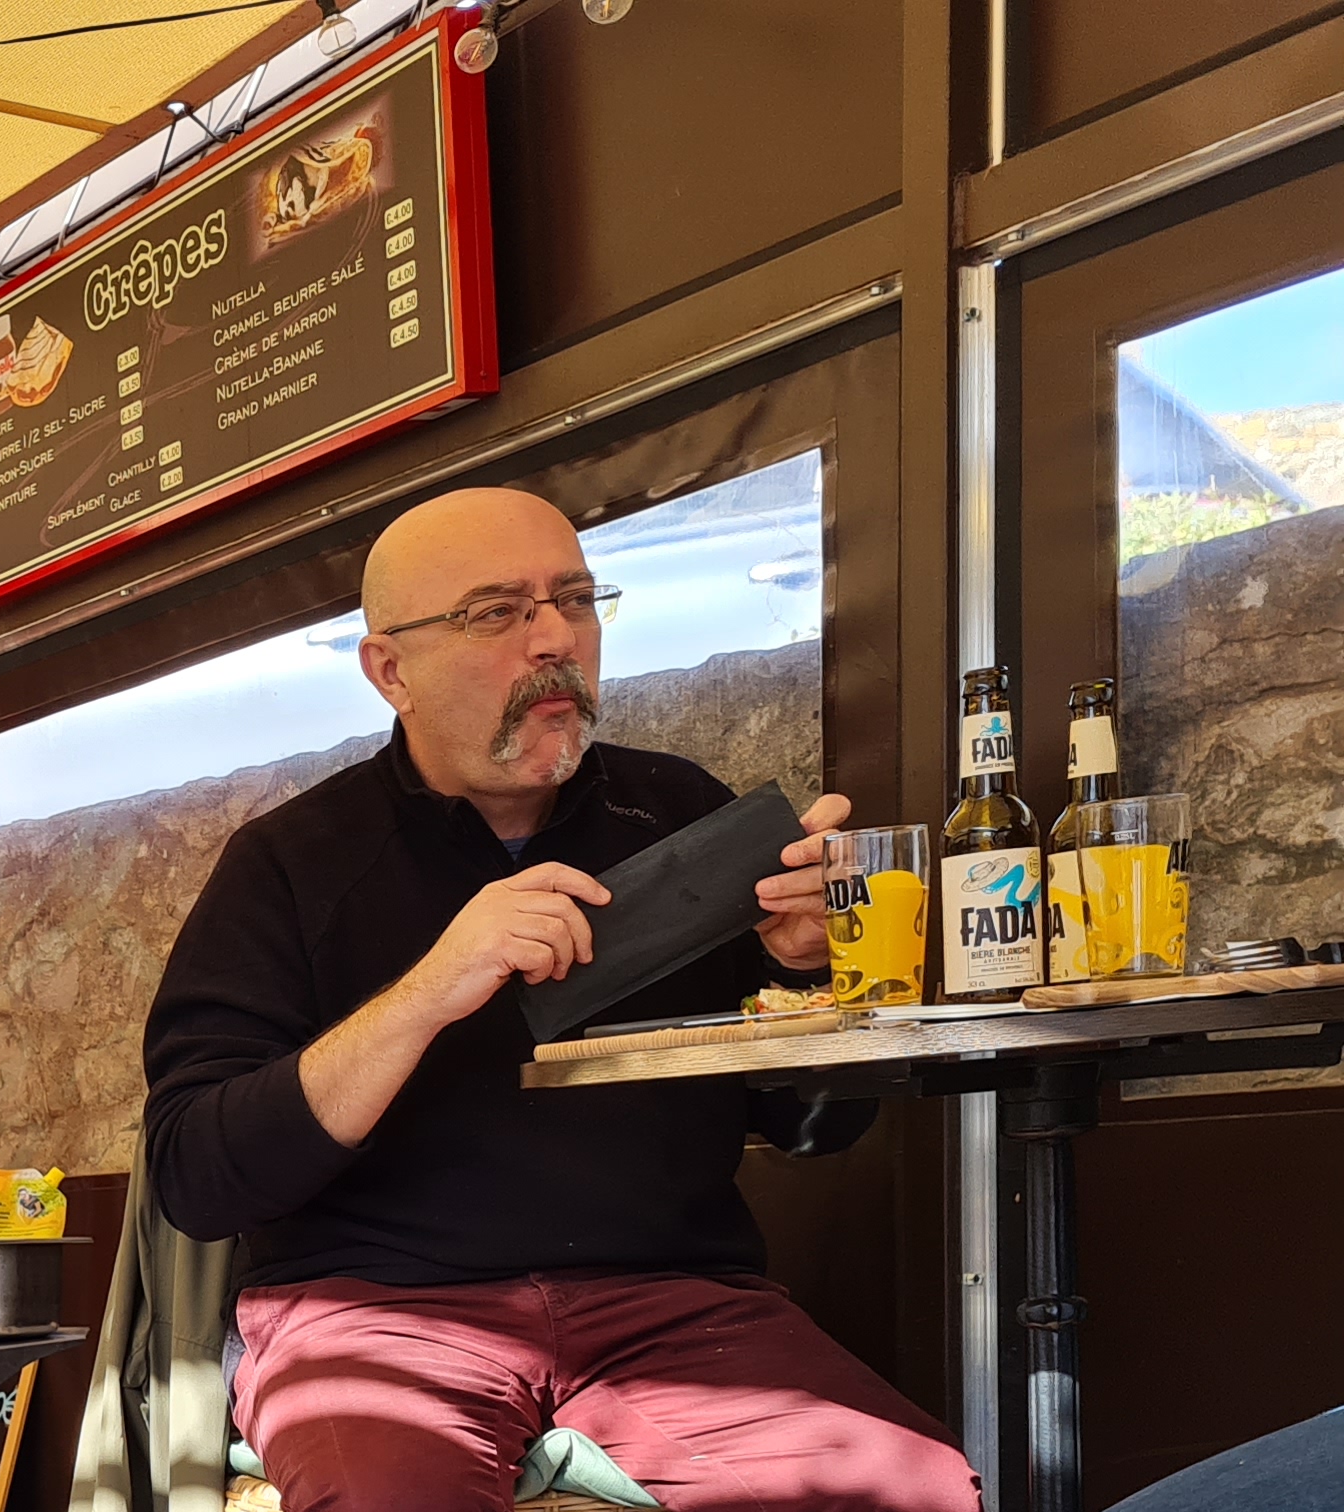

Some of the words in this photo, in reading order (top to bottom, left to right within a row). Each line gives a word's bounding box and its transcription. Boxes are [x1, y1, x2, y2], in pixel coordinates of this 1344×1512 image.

[84, 208, 228, 331] Crêpes
[212, 281, 266, 319] NUTELLA
[213, 310, 270, 347] CARAMEL
[273, 277, 327, 316] BEURRE
[331, 251, 365, 287] SALÉ
[214, 343, 258, 375] CRÈME
[262, 332, 280, 352] DE
[283, 302, 337, 341] MARRON
[216, 339, 325, 403] NUTELLA-BANANE
[69, 395, 107, 424] SUCRE
[217, 401, 259, 430] GRAND
[263, 373, 318, 409] MARNIER
[108, 455, 156, 487] CHANTILLY
[47, 493, 107, 530] SUPPLÉMENT
[109, 489, 143, 513] GLACE
[824, 874, 872, 911] ADA
[960, 899, 1038, 948] FADA
